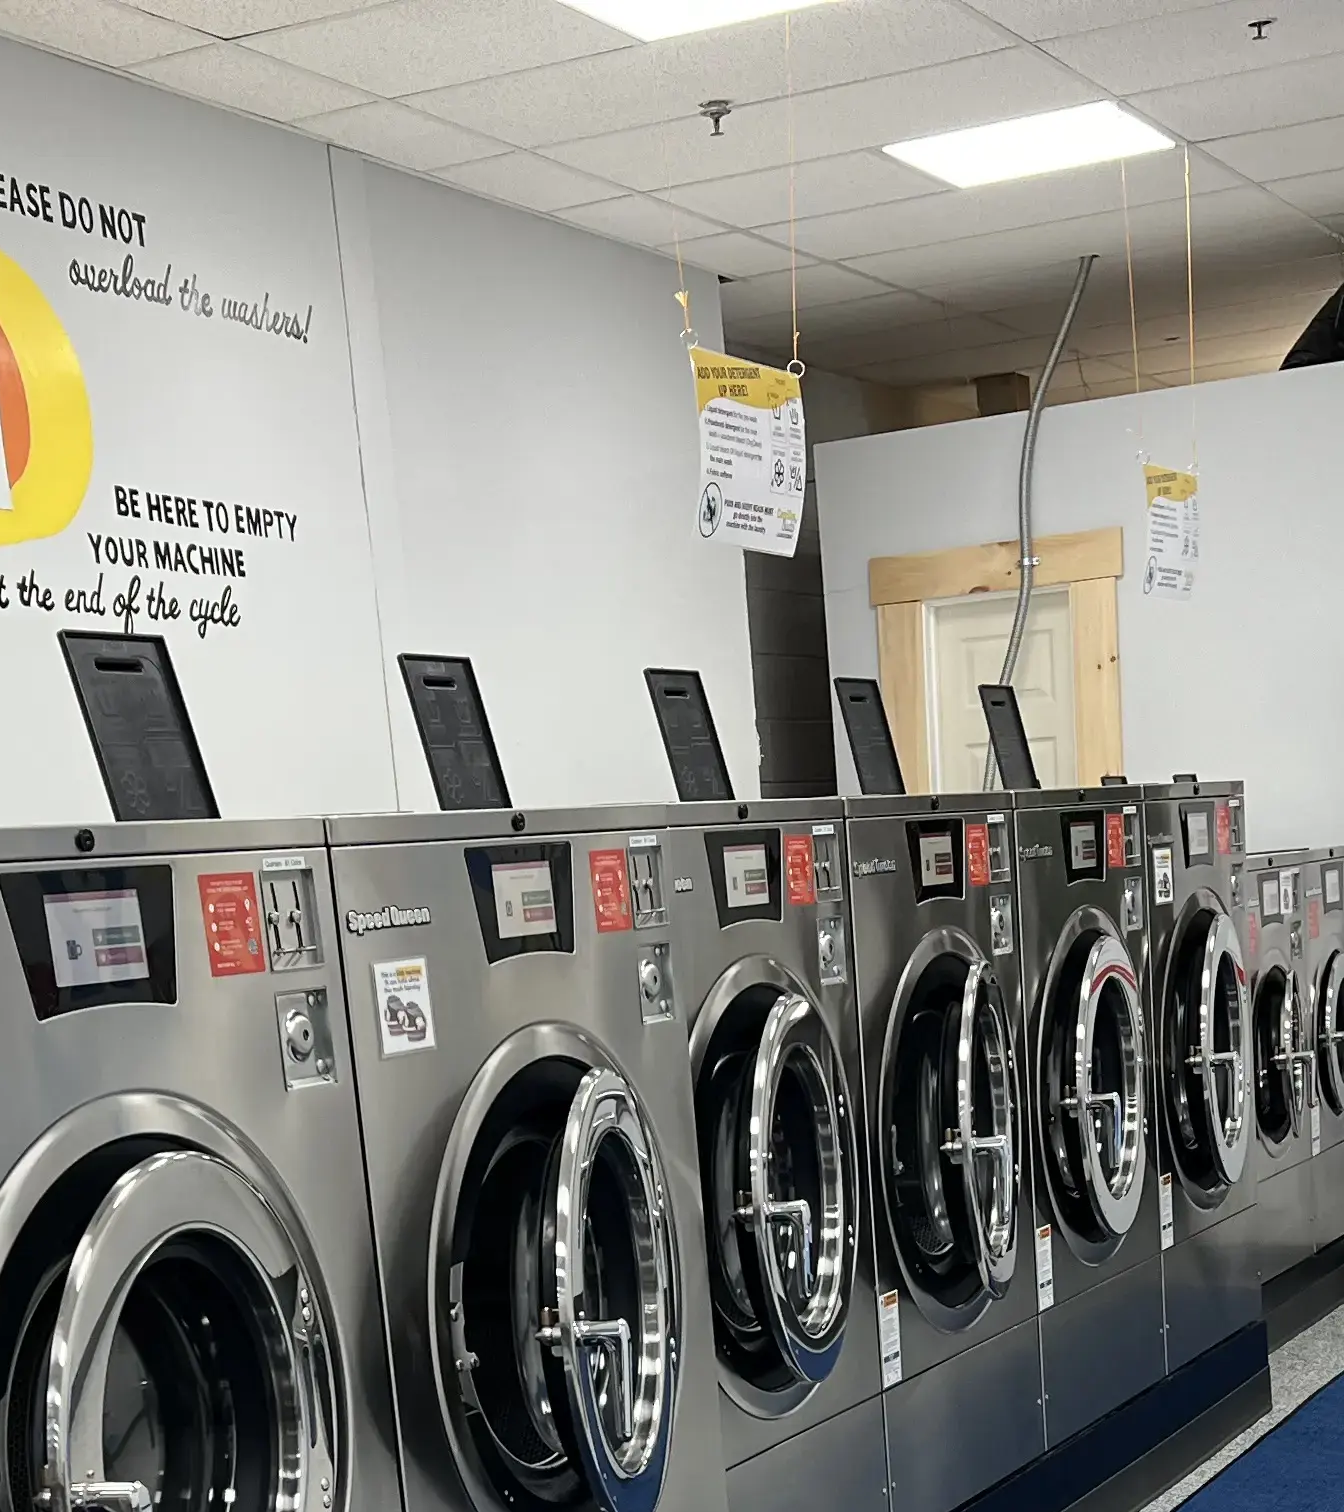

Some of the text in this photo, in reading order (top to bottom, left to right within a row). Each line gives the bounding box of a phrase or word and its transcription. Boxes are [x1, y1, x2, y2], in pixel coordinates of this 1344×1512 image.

[58, 191, 94, 235] DO
[98, 203, 146, 248] NOT
[68, 253, 312, 344] overload the washers!
[114, 484, 298, 543] BE HERE TO EMPTY
[86, 532, 246, 578] YOUR MACHINE
[16, 568, 56, 611] the
[64, 572, 106, 618] end
[112, 574, 141, 634] of
[146, 581, 182, 621] the
[189, 585, 241, 639] cycle
[346, 905, 431, 936] Speed Queen
